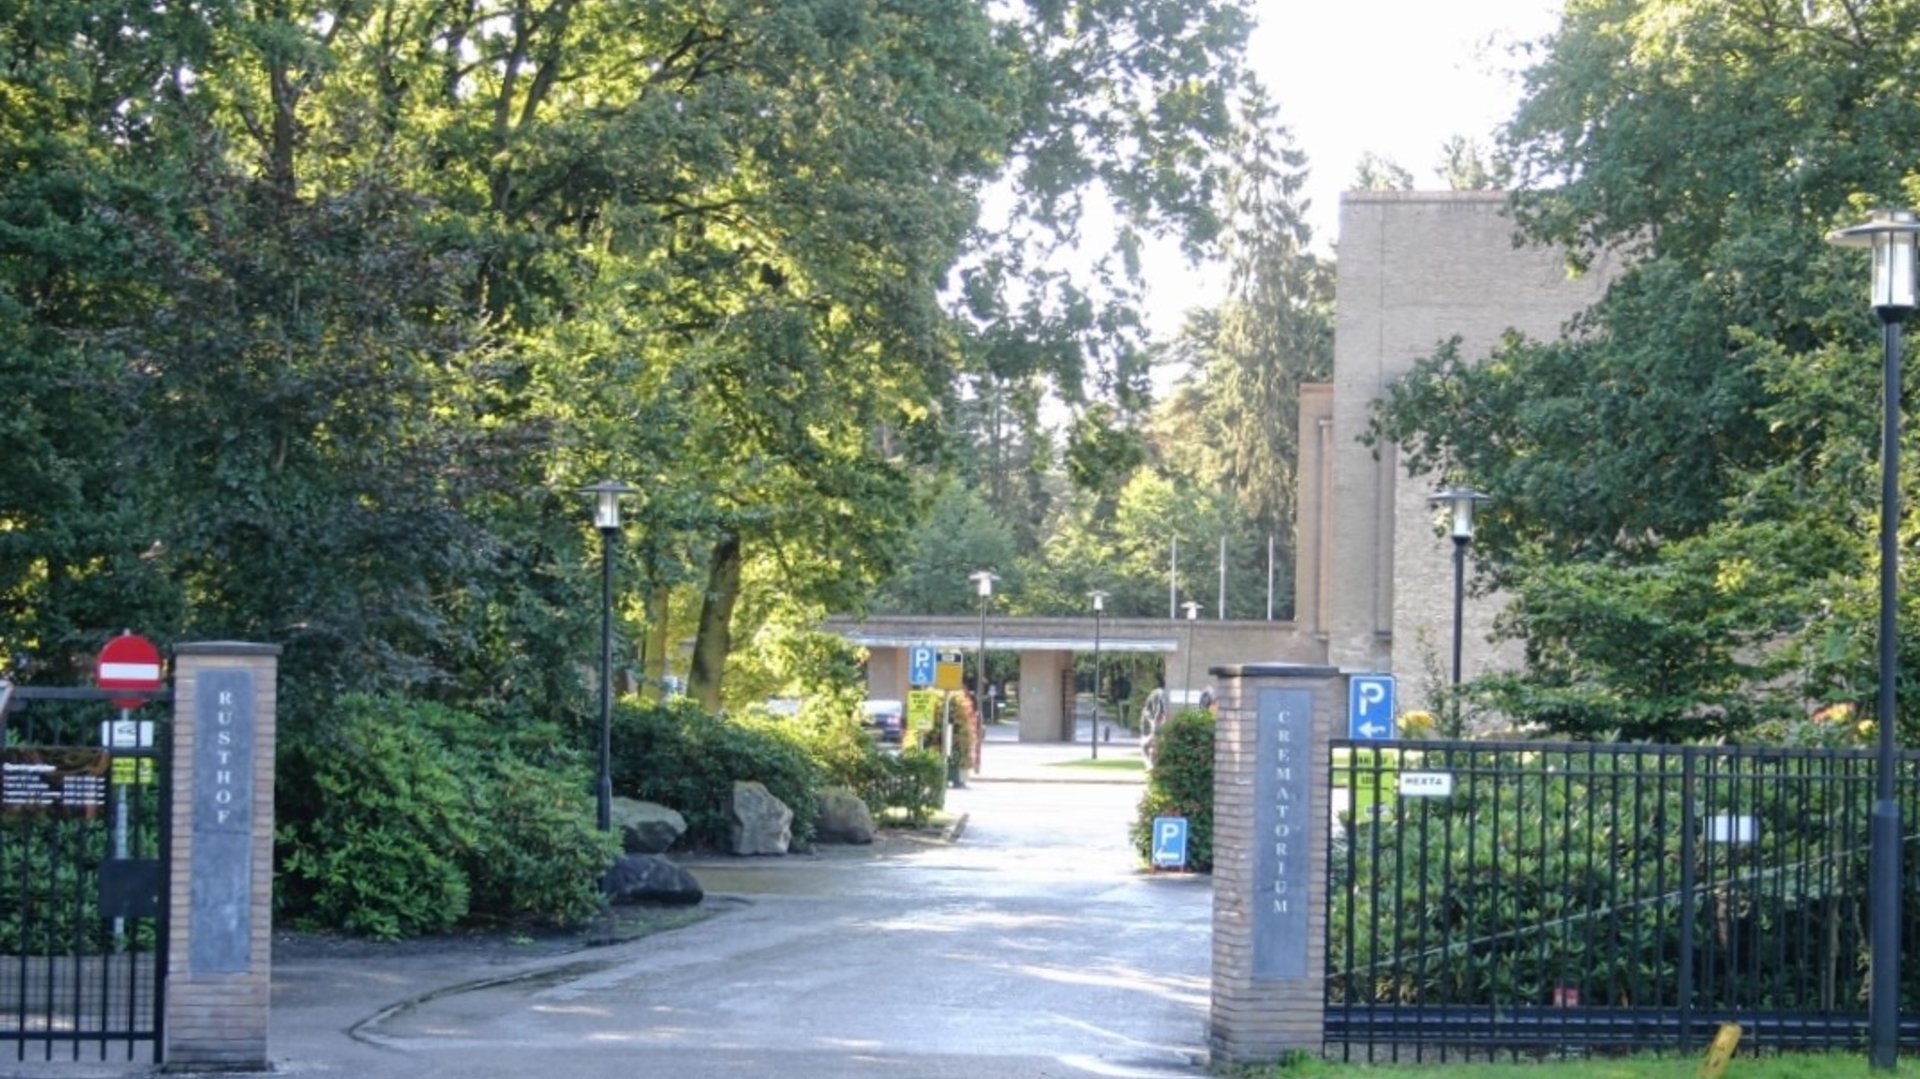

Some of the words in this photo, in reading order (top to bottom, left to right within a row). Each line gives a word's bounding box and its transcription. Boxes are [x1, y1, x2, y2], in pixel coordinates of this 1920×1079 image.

[915, 649, 931, 668] P
[1359, 682, 1385, 716] P
[216, 691, 232, 823] RUSTHOF
[1273, 711, 1291, 913] CREMATORIUM
[1162, 822, 1179, 846] P
